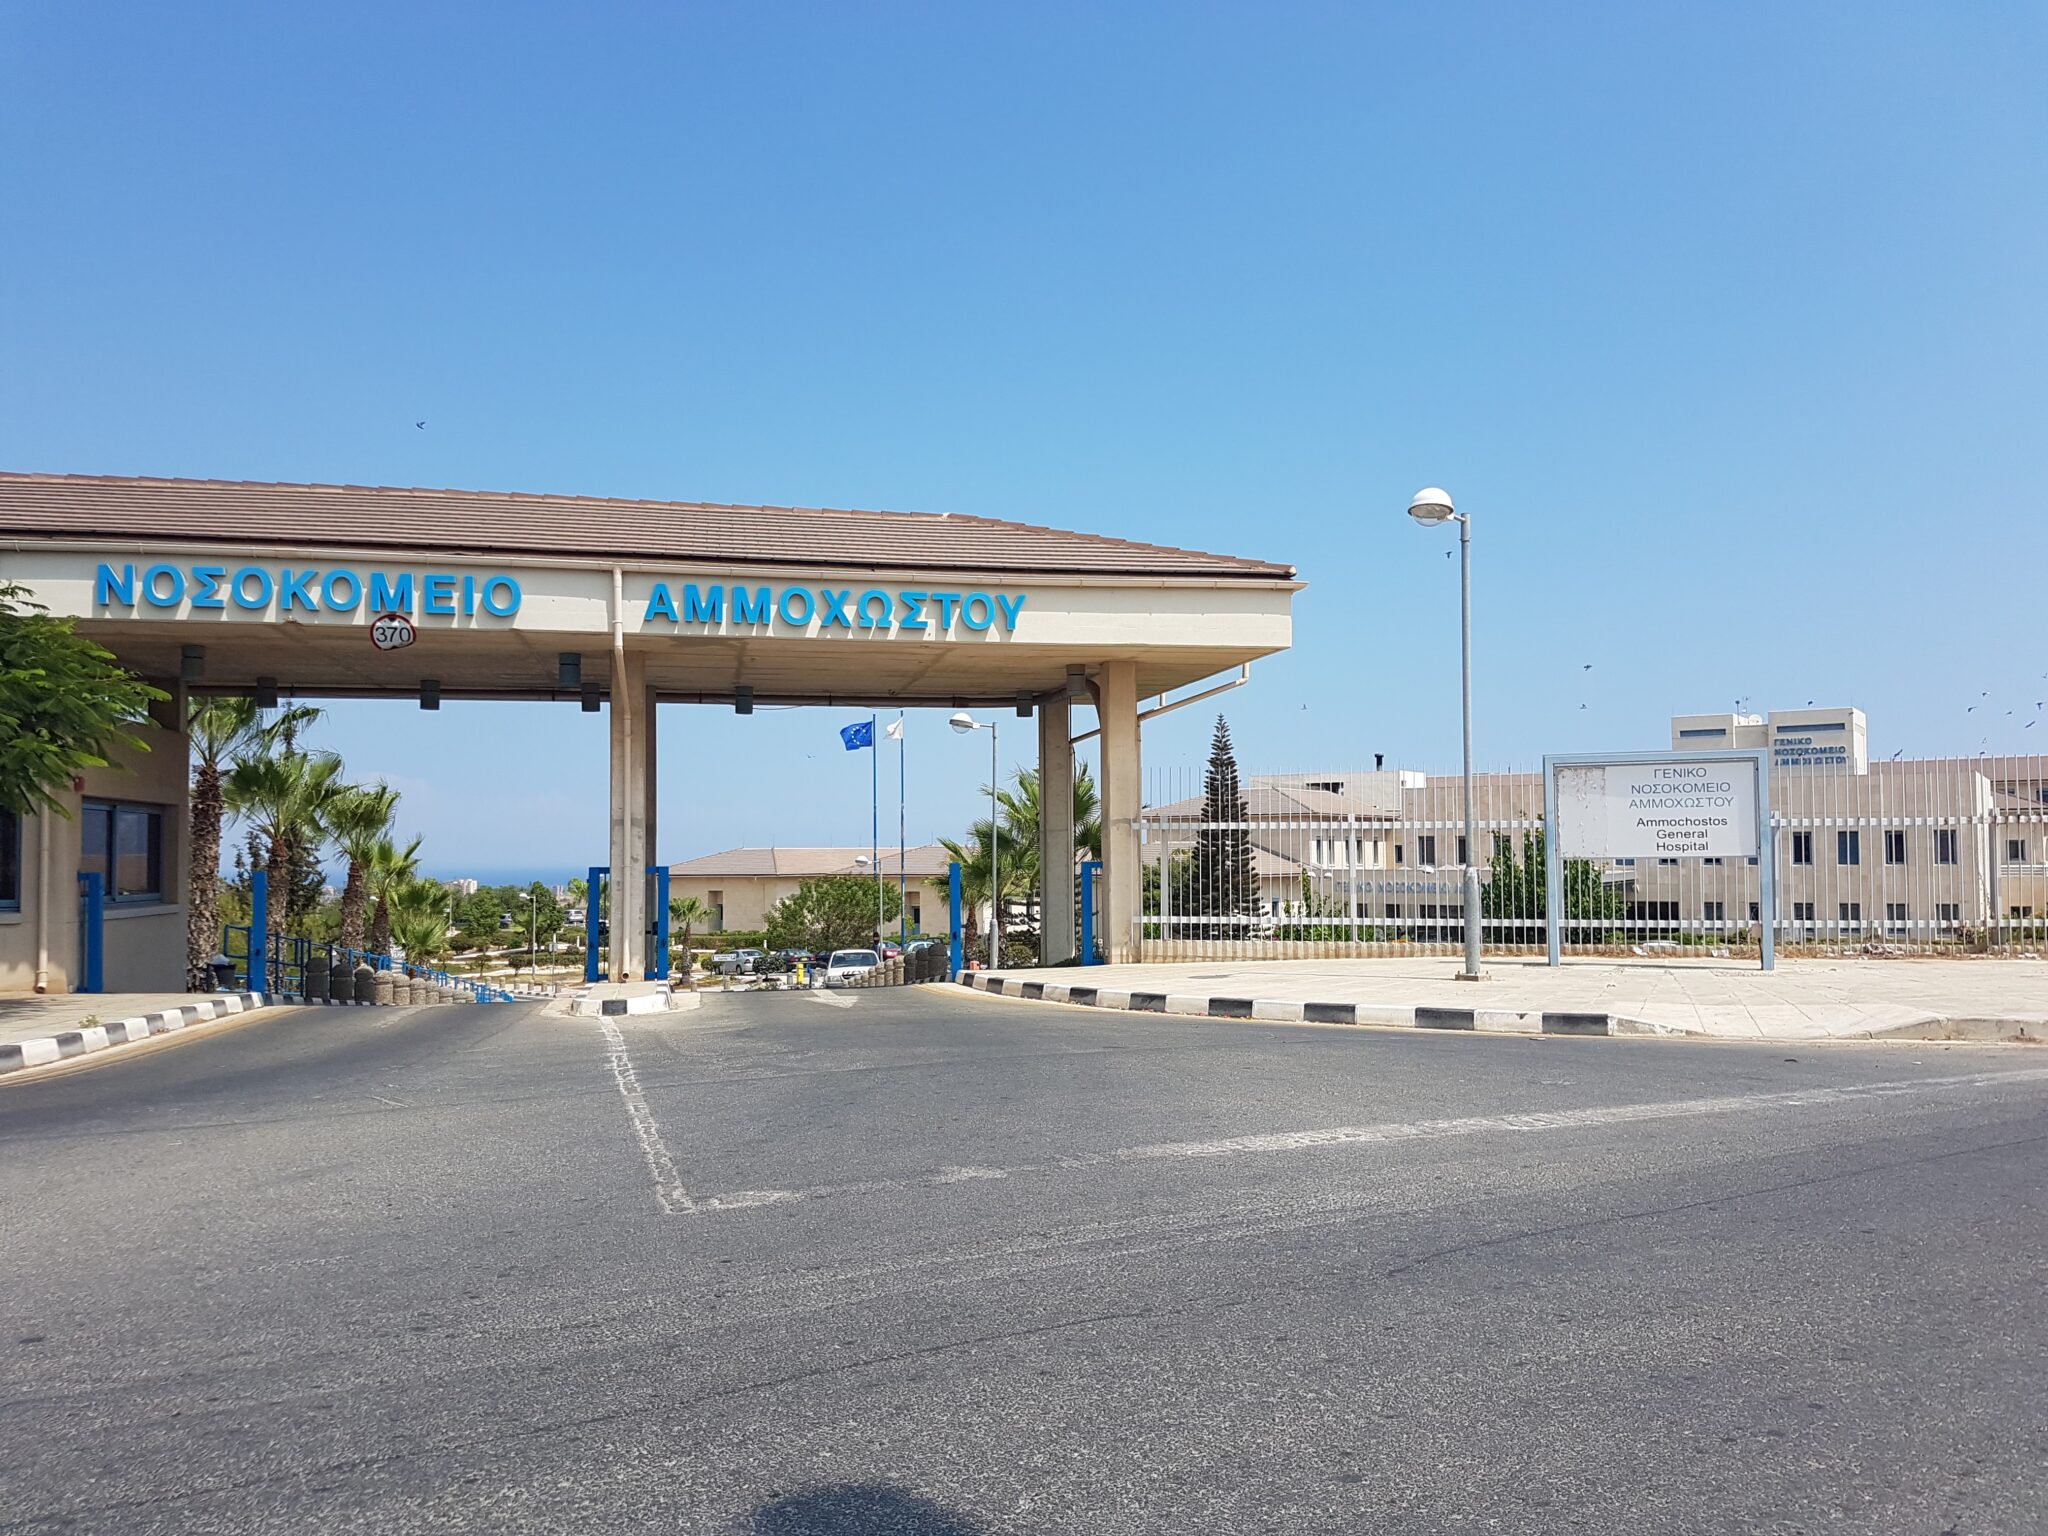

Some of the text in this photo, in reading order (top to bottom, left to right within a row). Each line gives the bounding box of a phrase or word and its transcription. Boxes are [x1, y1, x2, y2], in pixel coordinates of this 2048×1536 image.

[97, 562, 1027, 631] ΝΟΣΟΚΟΜΕΙΟ ΑΜΜΟΧΩΣΤΟΥ
[375, 625, 412, 645] 370
[1774, 737, 1812, 747] ΓΕΝΙΚΟ
[1774, 746, 1846, 756] ΝΟΣΟΚΟΜΕΙΟ
[1653, 767, 1708, 779] ΓΕΝΙΚΟ
[1630, 781, 1731, 795] ΝΟΣΟΚΟΜΕΙΟ
[1628, 796, 1735, 809] ΑΜΜΟΧΩΣΤΟΥ
[1636, 816, 1728, 828] Ammochostos
[1656, 829, 1708, 839] General
[1656, 841, 1709, 854] Hospital
